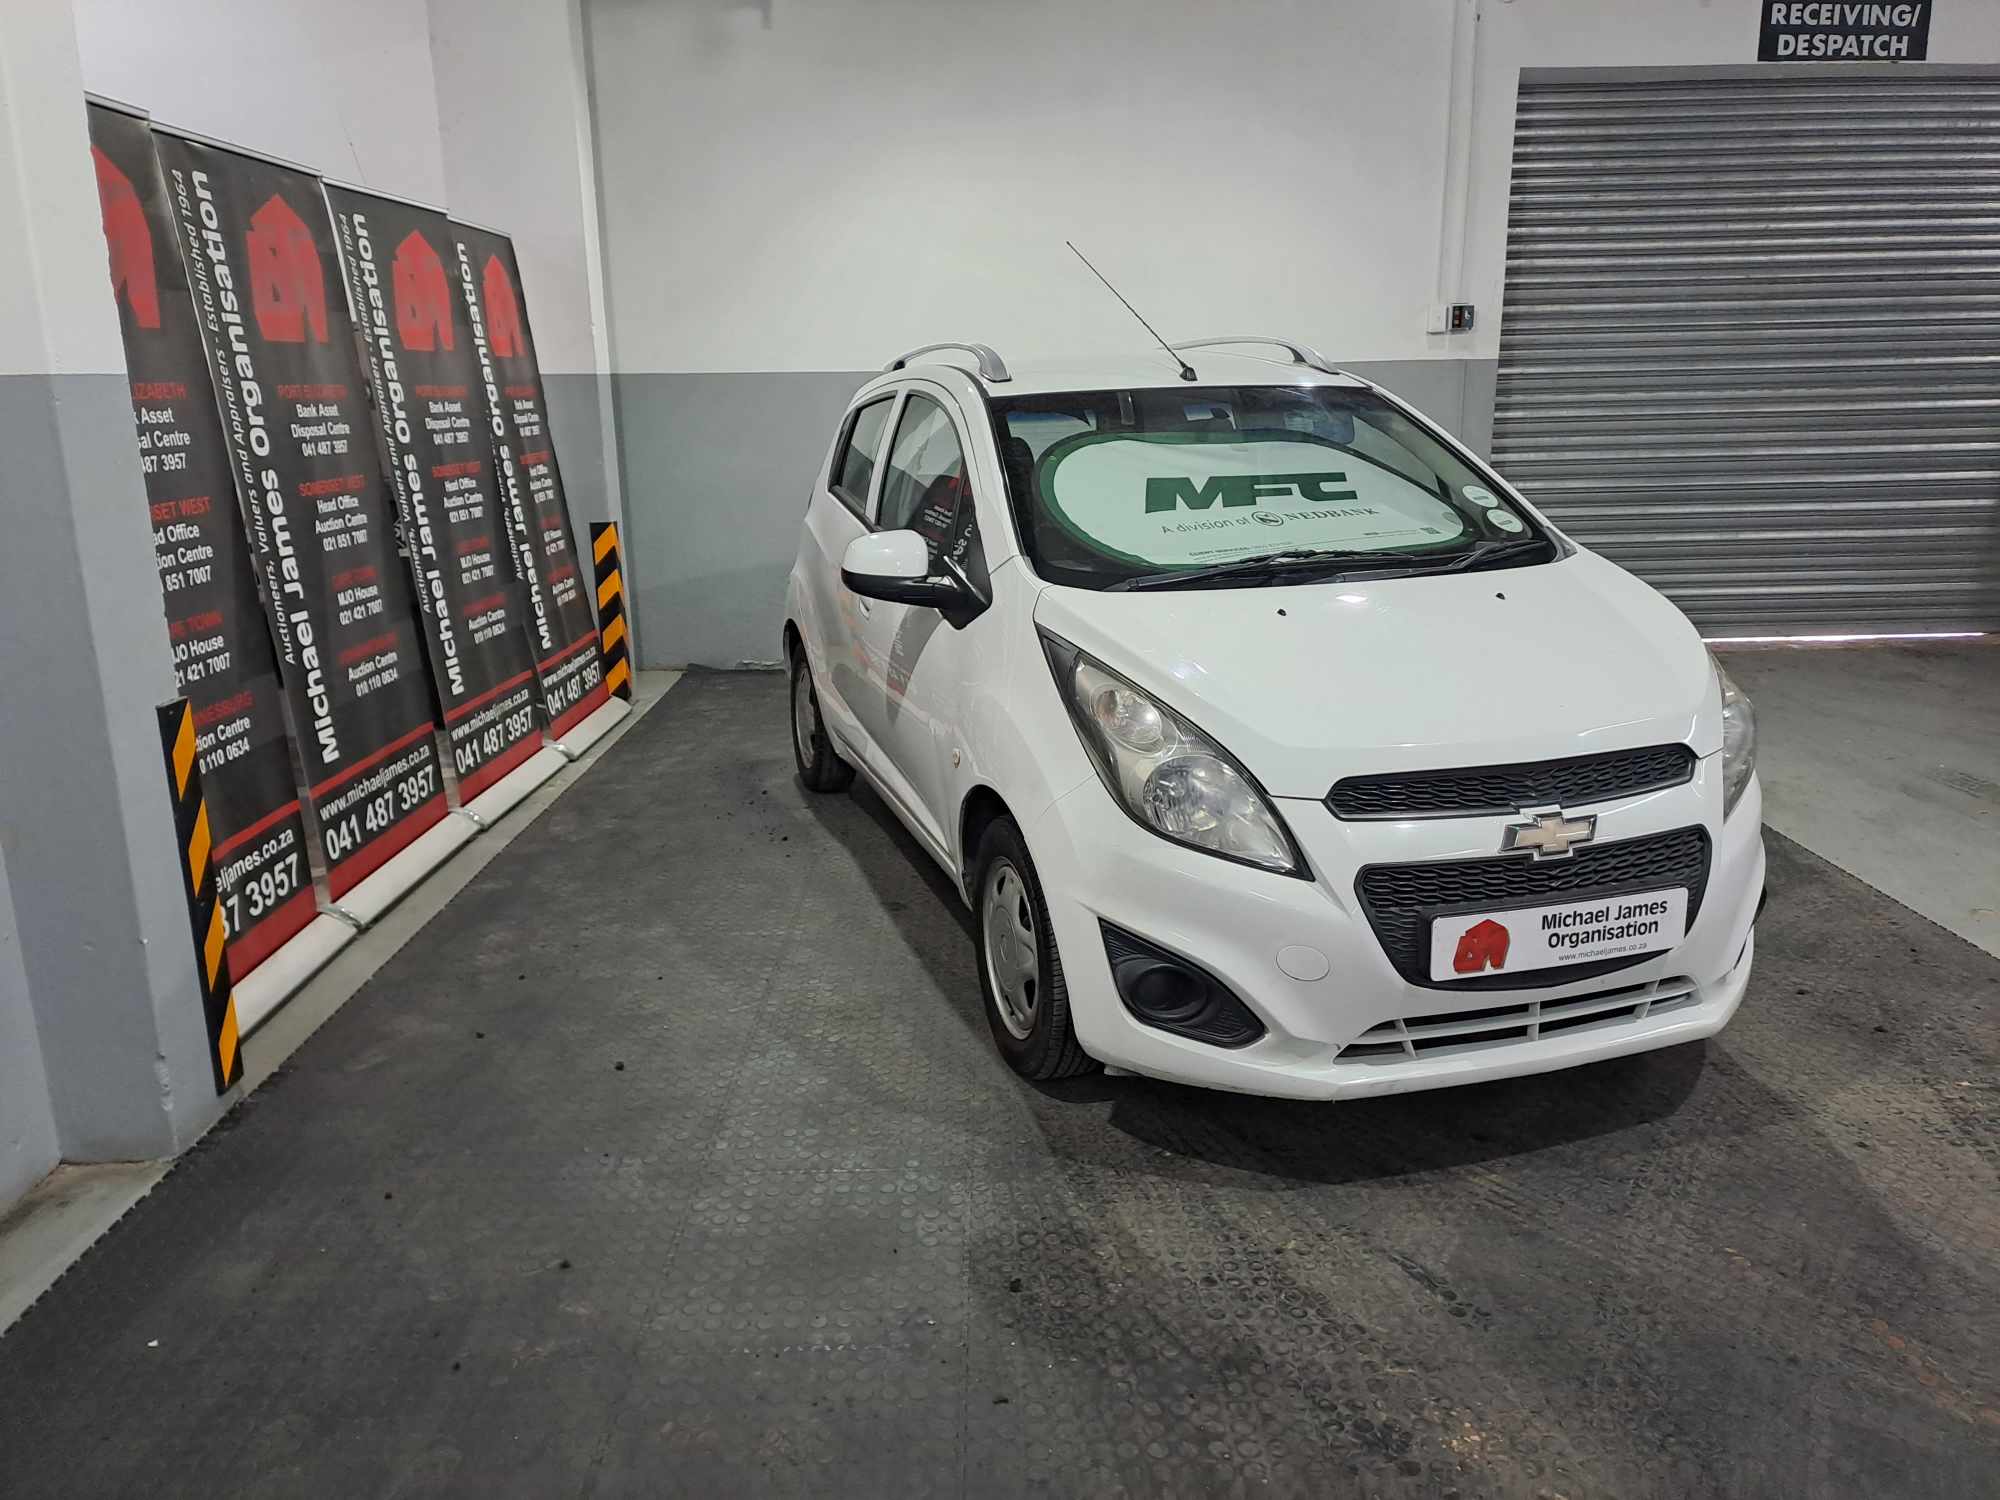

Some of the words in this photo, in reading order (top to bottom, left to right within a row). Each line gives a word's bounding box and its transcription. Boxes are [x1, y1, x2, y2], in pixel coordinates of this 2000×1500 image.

[1770, 3, 1922, 27] RECEIVING/
[1776, 33, 1909, 57] DESPATCH
[171, 169, 192, 217] 1964
[184, 222, 219, 332] Established
[192, 170, 270, 457] Organisation
[352, 213, 410, 444] Organisation
[456, 242, 504, 437] Organisation
[141, 407, 174, 424] Asset
[216, 349, 248, 445] Appraisers
[153, 430, 191, 448] Centre
[161, 453, 187, 470] 3957
[237, 449, 254, 484] and
[404, 453, 437, 560] James
[500, 444, 527, 537] James
[1145, 471, 1358, 514] MFC
[167, 523, 199, 542] Office
[248, 489, 270, 553] Valuers
[261, 468, 304, 599] James
[1176, 519, 1233, 534] division
[1236, 516, 1250, 527] of
[1283, 507, 1379, 522] NEDBANK
[177, 545, 213, 564] Centre
[165, 571, 185, 591] 851
[187, 565, 211, 586] 7007
[519, 543, 552, 650] Michael
[189, 635, 225, 656] House
[426, 569, 465, 696] Michael
[187, 662, 205, 681] 421
[207, 652, 231, 674] 7007
[290, 610, 340, 764] Michael
[546, 688, 567, 716] 041
[567, 676, 582, 700] 487
[584, 660, 601, 690] 3957
[217, 717, 250, 741] Centre
[226, 736, 250, 759] 0634
[455, 737, 481, 774] 041
[483, 722, 503, 755] 487
[505, 705, 532, 740] 3957
[320, 744, 430, 821] www.michaeljames.co.za
[326, 813, 361, 860] 041
[365, 791, 395, 833] 487
[398, 764, 434, 811] 3957
[245, 852, 298, 917] 3957
[1541, 907, 1609, 930] Michael
[1614, 899, 1668, 921] James
[1548, 920, 1659, 949] Organisation
[1558, 942, 1648, 962] www.michaeljames.co.za
